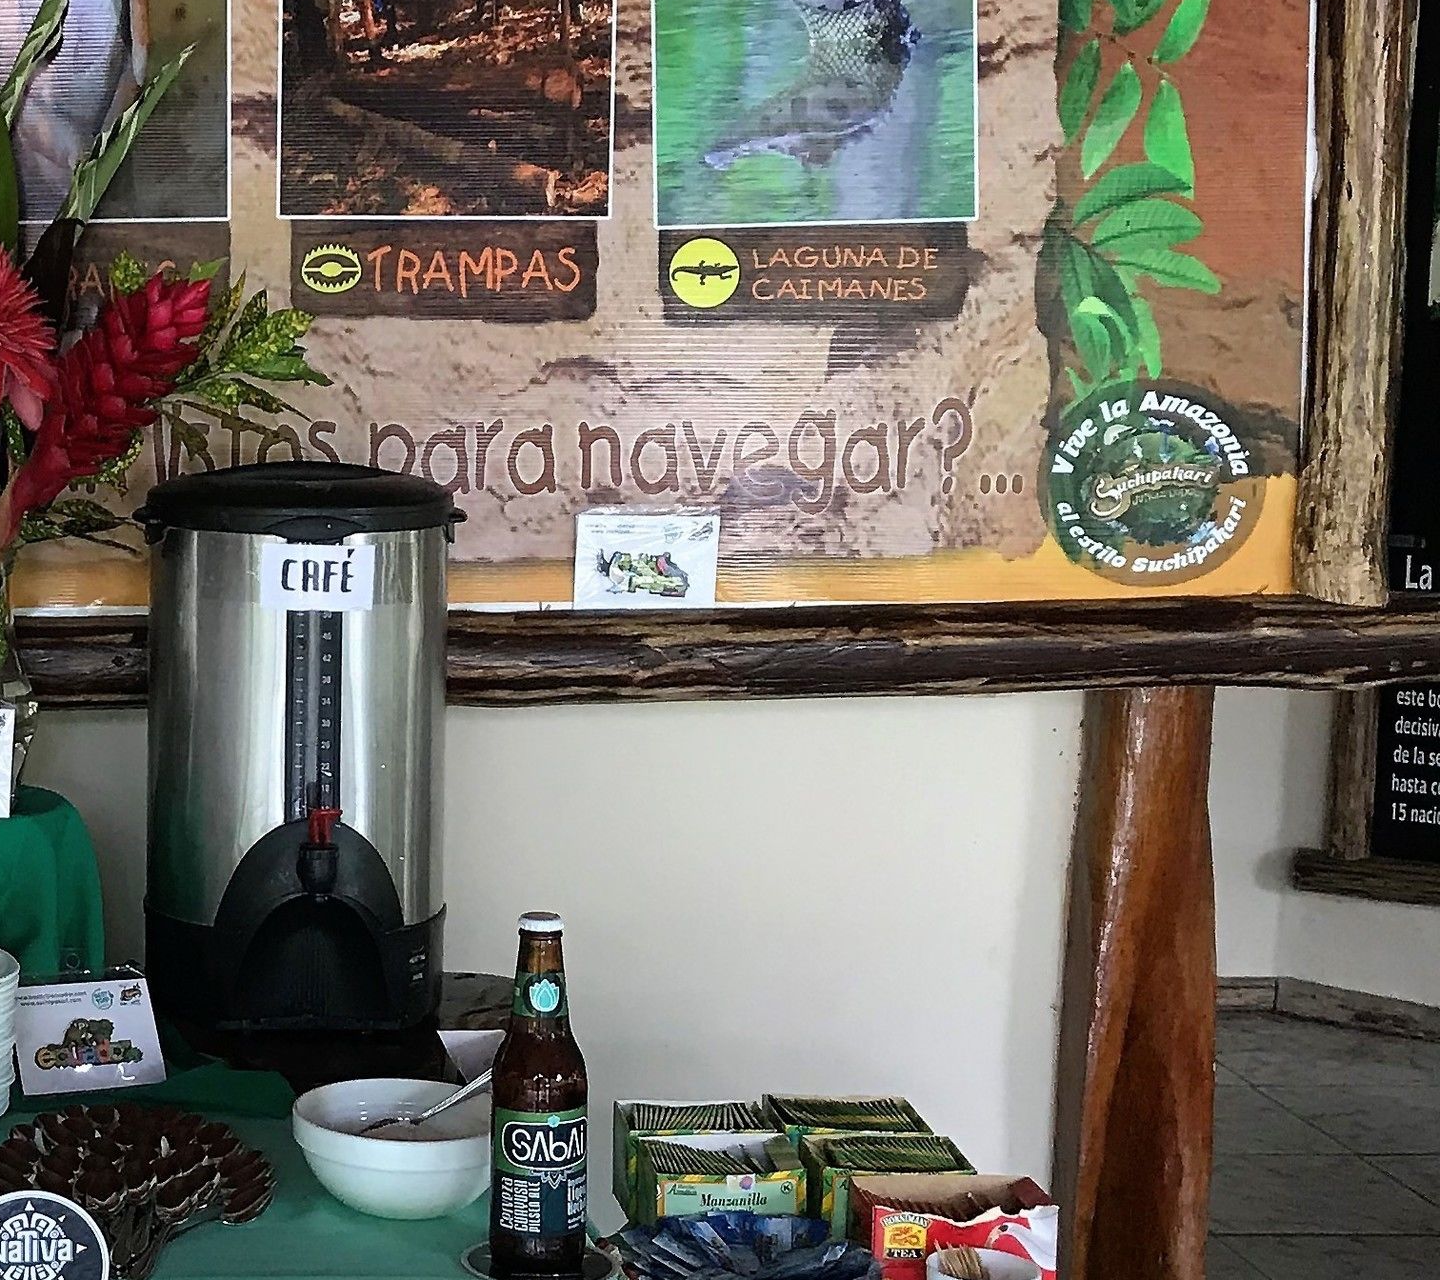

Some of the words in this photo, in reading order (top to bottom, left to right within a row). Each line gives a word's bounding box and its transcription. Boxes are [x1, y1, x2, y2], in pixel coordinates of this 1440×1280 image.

[752, 245, 885, 270] LAGUNA
[896, 246, 939, 270] DE
[367, 245, 581, 298] TRAMPAS
[752, 276, 928, 302] CAIMANES
[1051, 417, 1099, 475] Vive
[1098, 398, 1131, 423] la
[1138, 390, 1251, 476] Amazonia
[1056, 500, 1081, 523] al
[1068, 524, 1128, 569] estilo
[1131, 496, 1248, 573] Suchipakari
[280, 548, 354, 594] CAFÉ
[1404, 554, 1433, 590] La
[1396, 689, 1425, 707] este
[1394, 715, 1440, 738] decisiv
[1392, 743, 1410, 764] de
[1412, 745, 1425, 765] la
[1391, 772, 1427, 795] hasta
[1430, 781, 1440, 796] c
[1391, 802, 1407, 822] 15
[699, 1192, 768, 1208] Manzanilla
[890, 1248, 919, 1258] TEA
